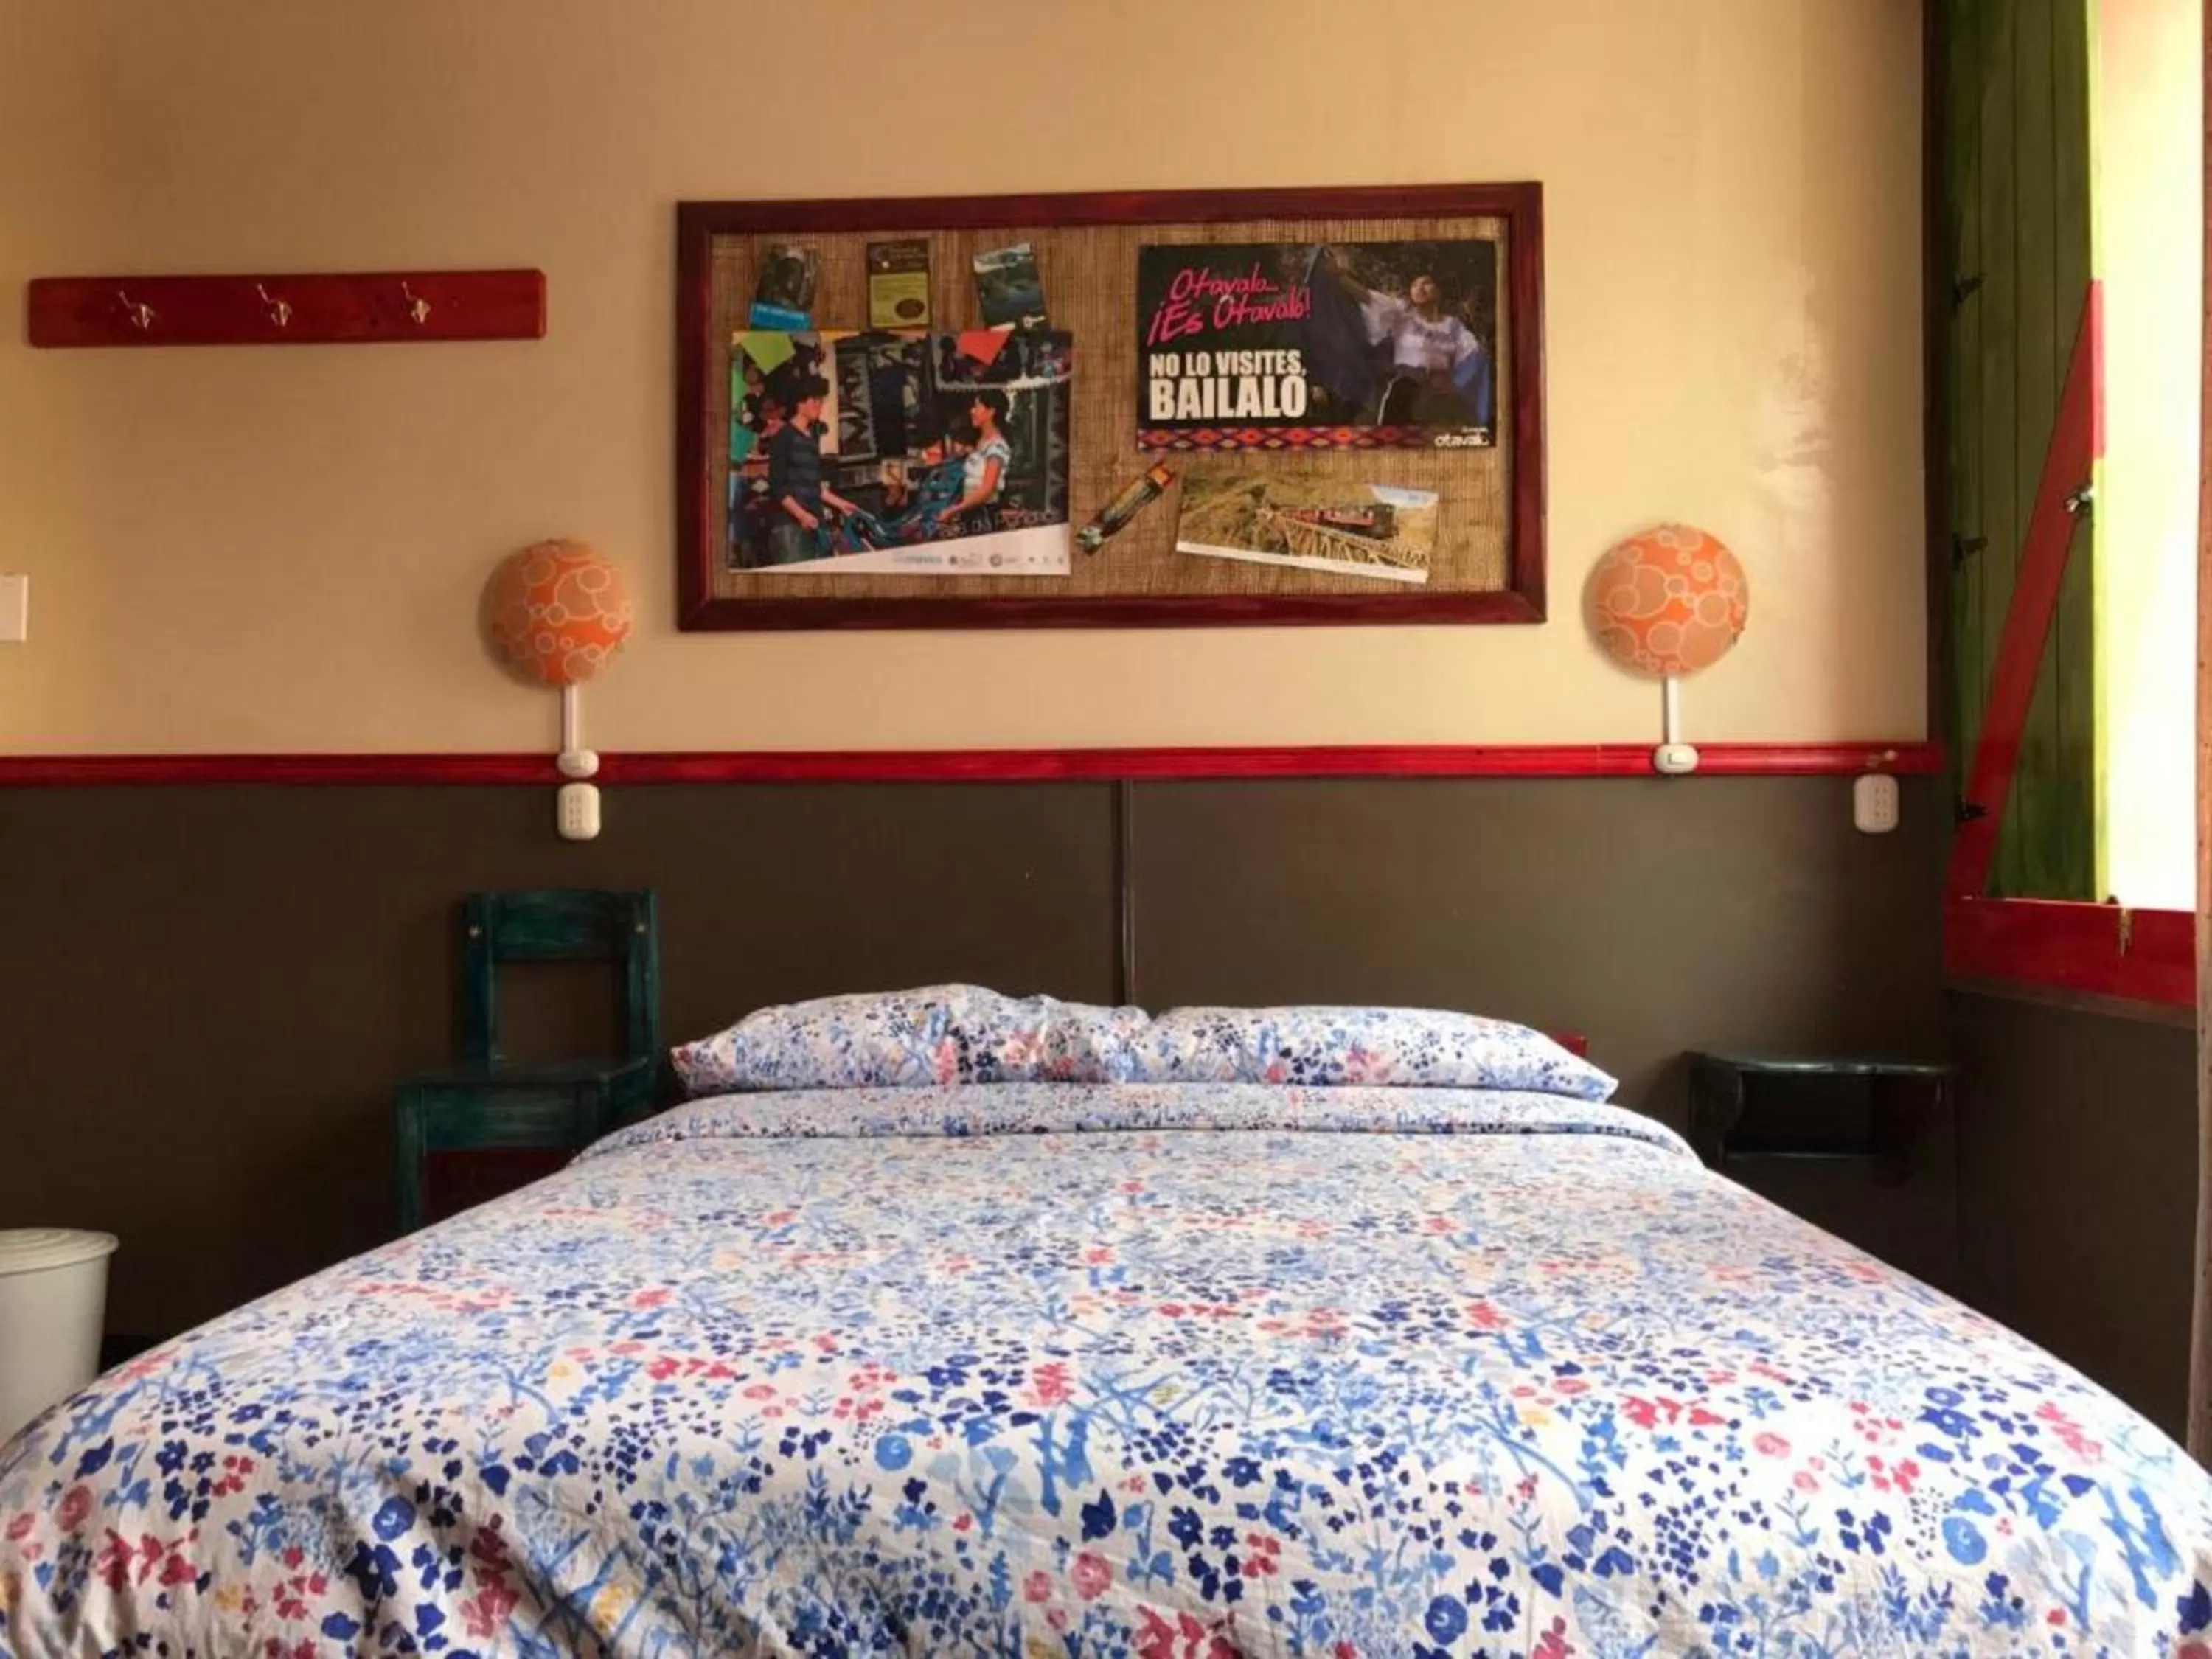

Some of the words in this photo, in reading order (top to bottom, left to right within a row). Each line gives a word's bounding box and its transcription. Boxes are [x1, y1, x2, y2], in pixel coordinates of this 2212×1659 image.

[1213, 285, 1310, 329] Otavalo!
[1150, 353, 1180, 377] NO
[1185, 352, 1211, 376] LO
[1215, 349, 1307, 376] VISITES,
[1149, 375, 1307, 420] BAILALO
